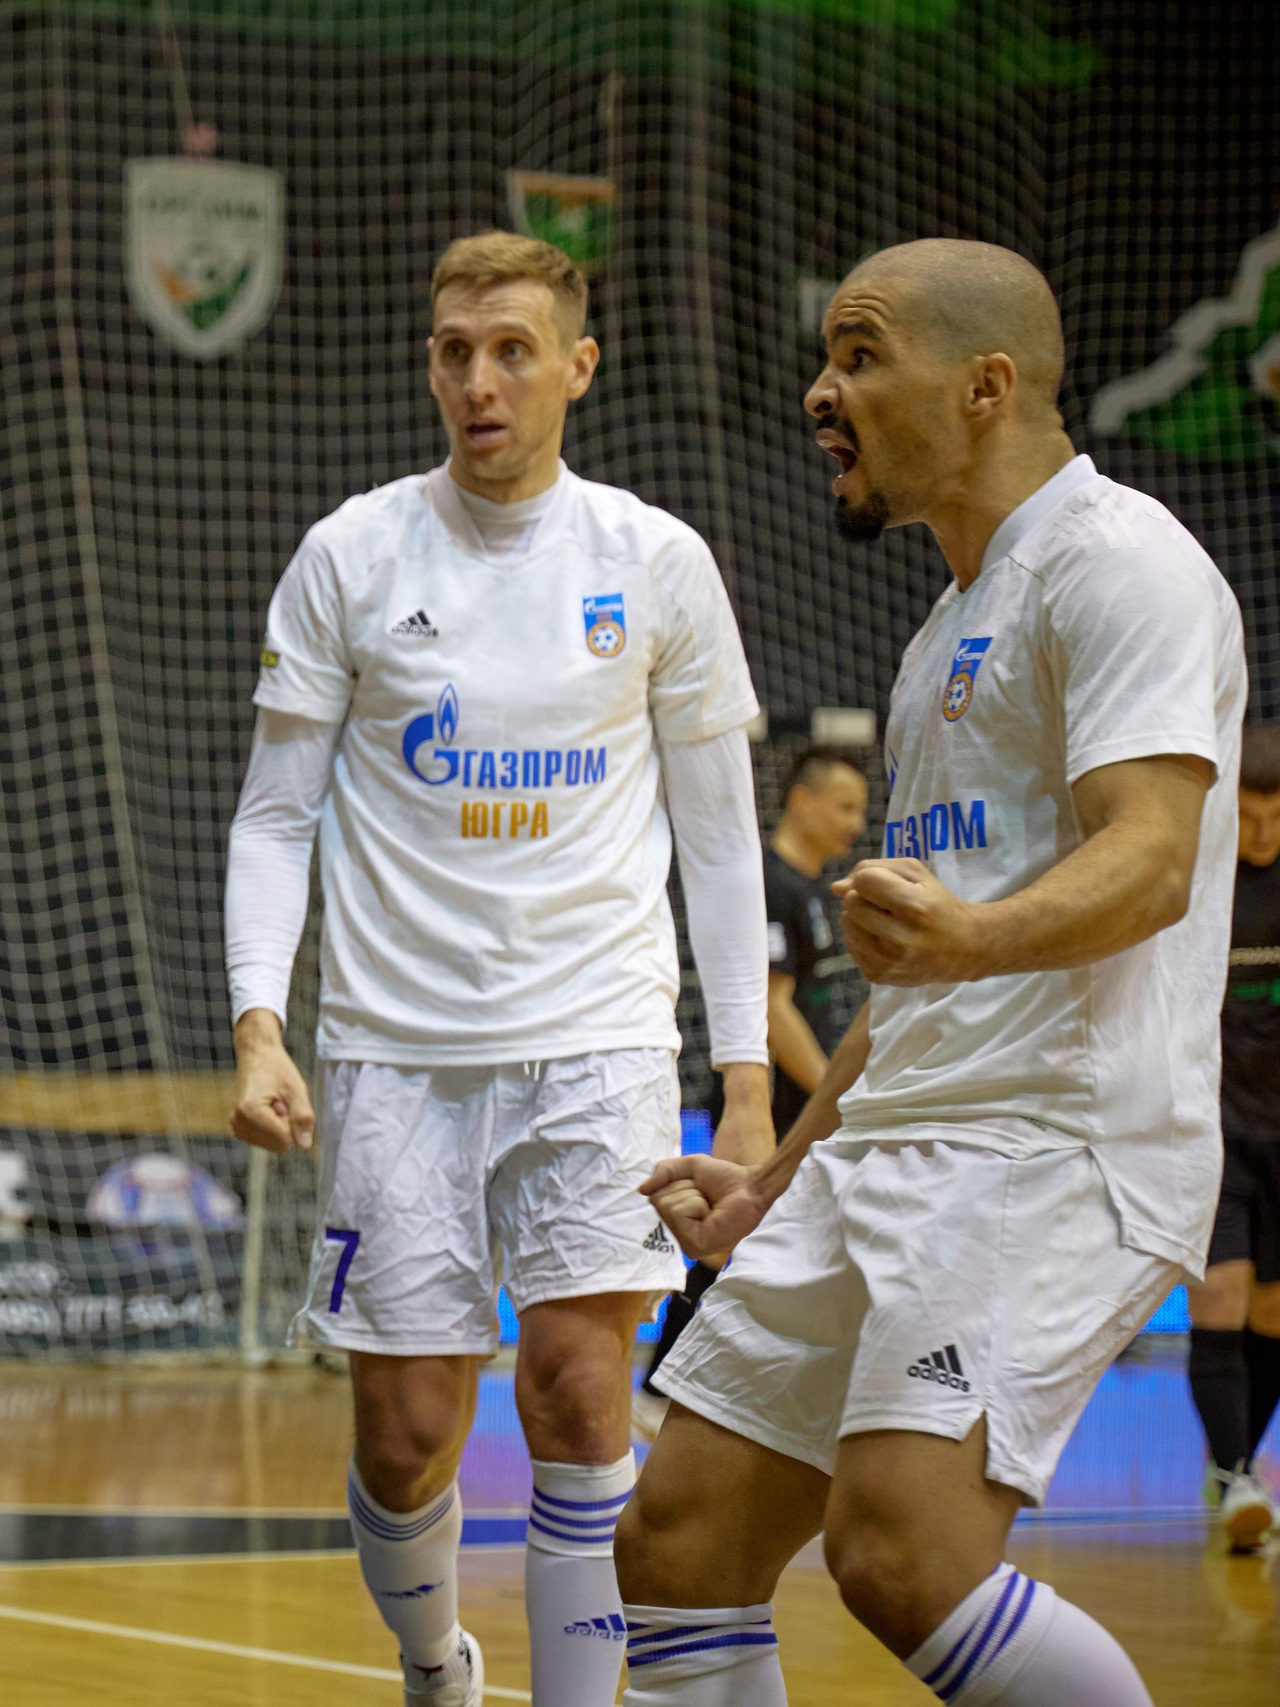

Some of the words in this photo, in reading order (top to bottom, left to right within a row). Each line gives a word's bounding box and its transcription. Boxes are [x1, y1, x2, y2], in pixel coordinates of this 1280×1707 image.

[463, 747, 606, 788] ГАЗПРОМ
[461, 801, 549, 838] ЮГРА
[326, 1228, 361, 1314] 7
[907, 1365, 969, 1393] adidas
[564, 1626, 624, 1641] adida
